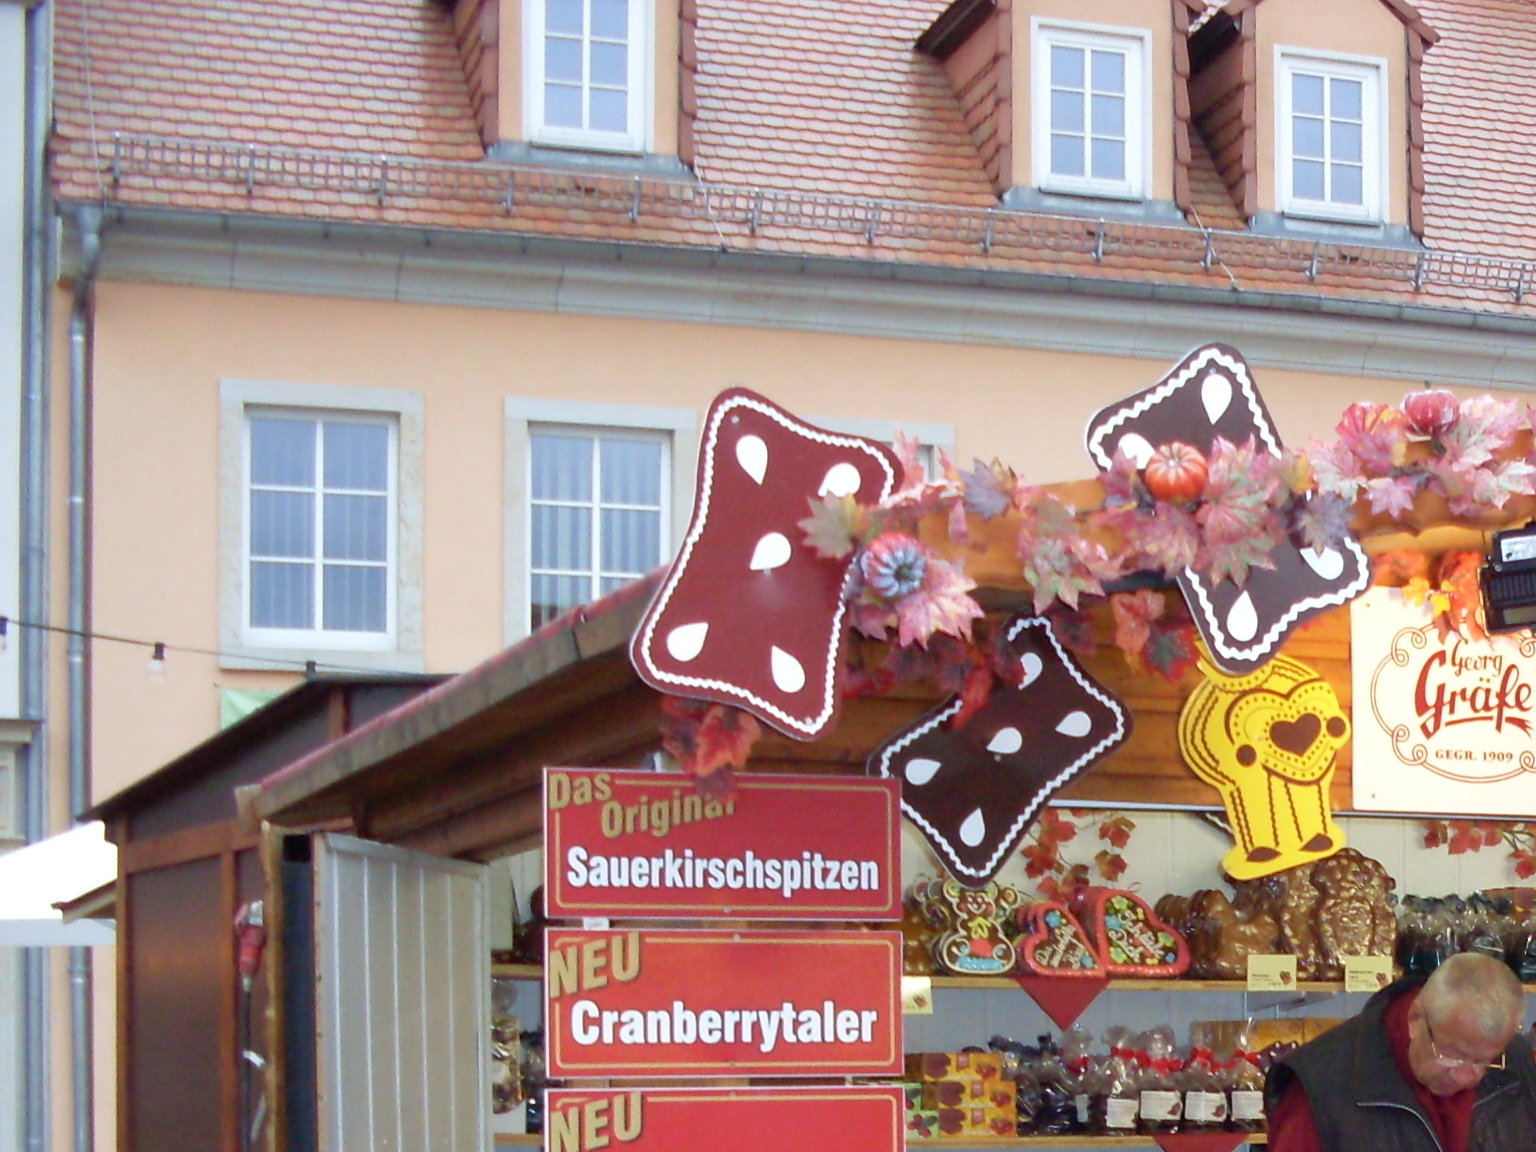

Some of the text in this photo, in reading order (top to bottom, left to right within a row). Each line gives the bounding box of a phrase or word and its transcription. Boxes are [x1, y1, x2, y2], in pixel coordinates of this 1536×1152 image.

[1451, 639, 1503, 677] Georg
[1415, 650, 1533, 739] Gräfe
[1435, 749, 1513, 763] GEGR. 1909
[548, 773, 612, 810] Das
[567, 846, 880, 897] Sauerkirschspitzen
[549, 932, 642, 998] NEU
[571, 1001, 878, 1053] Cranberrytaler
